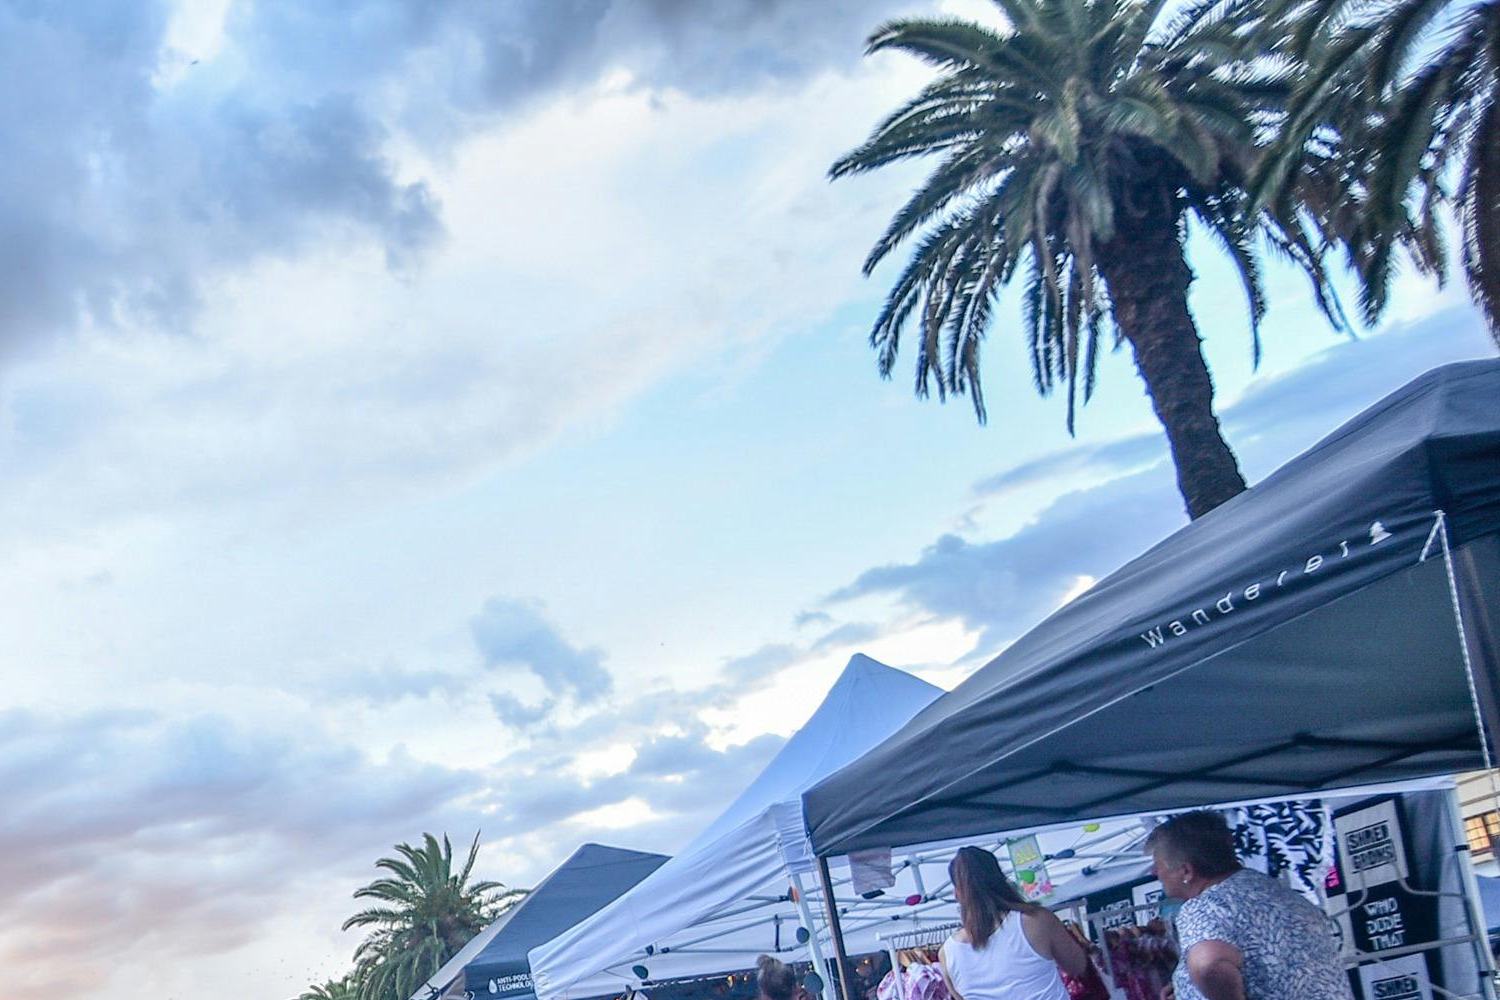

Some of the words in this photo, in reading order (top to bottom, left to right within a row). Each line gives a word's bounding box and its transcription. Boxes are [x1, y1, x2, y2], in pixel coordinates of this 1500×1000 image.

[1364, 897, 1398, 917] WHO
[497, 973, 532, 985] ANTI-POOL
[498, 980, 535, 992] TECHNOLOG
